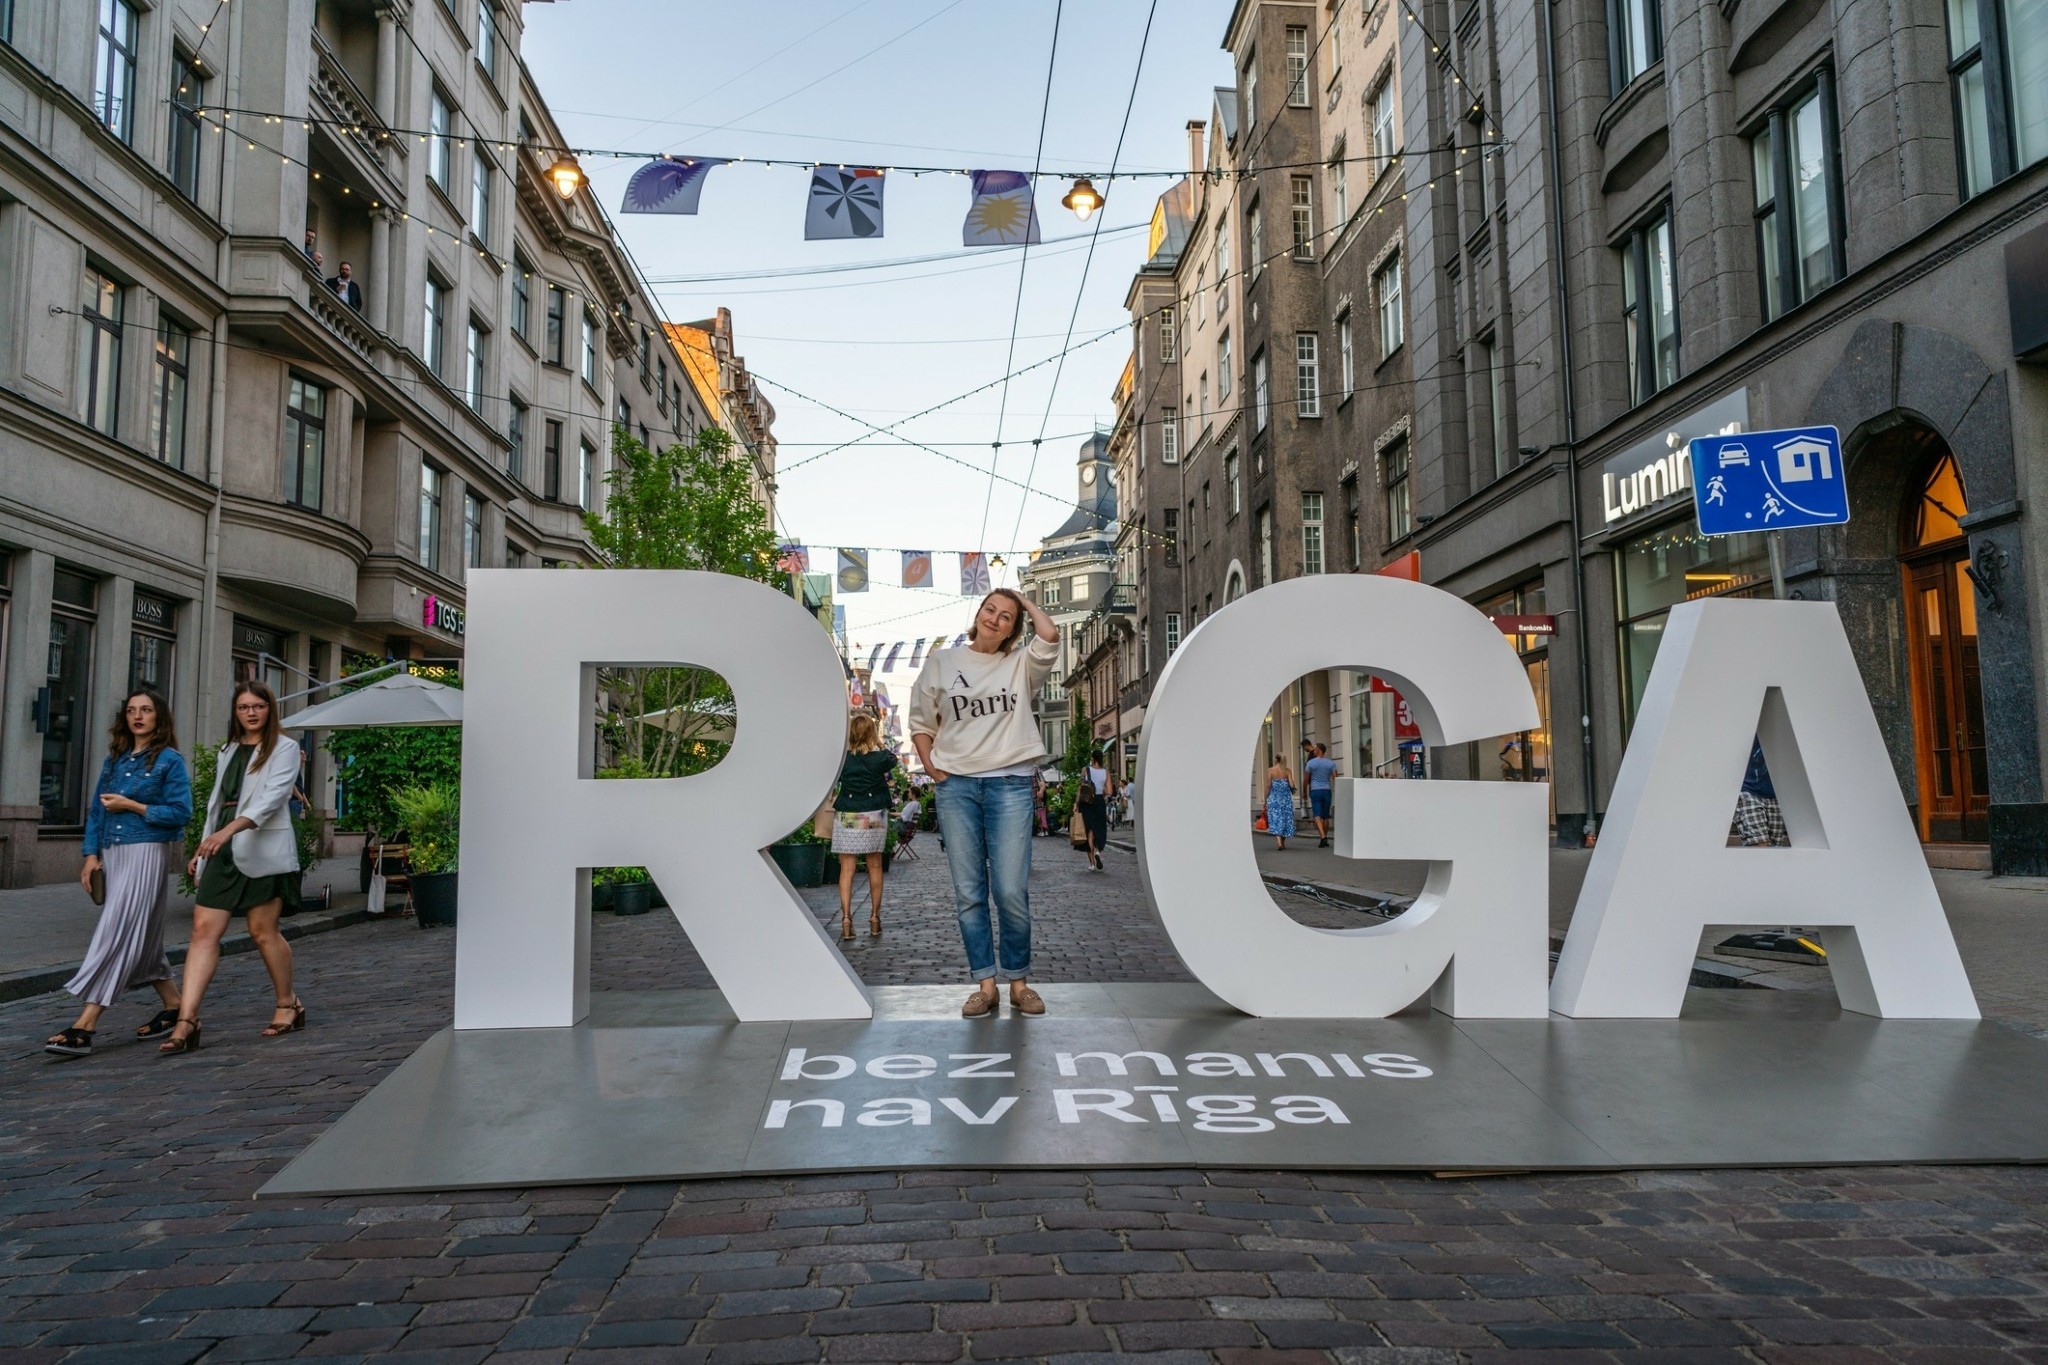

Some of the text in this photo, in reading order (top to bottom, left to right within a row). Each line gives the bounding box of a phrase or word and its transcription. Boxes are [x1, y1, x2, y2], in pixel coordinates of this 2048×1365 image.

[136, 598, 162, 618] BOSS
[437, 600, 457, 632] TGS
[245, 628, 265, 646] BOSS
[948, 669, 973, 690] À
[948, 687, 1018, 722] Paris
[780, 1047, 1016, 1081] bez
[764, 1086, 1352, 1133] nav Rīga
